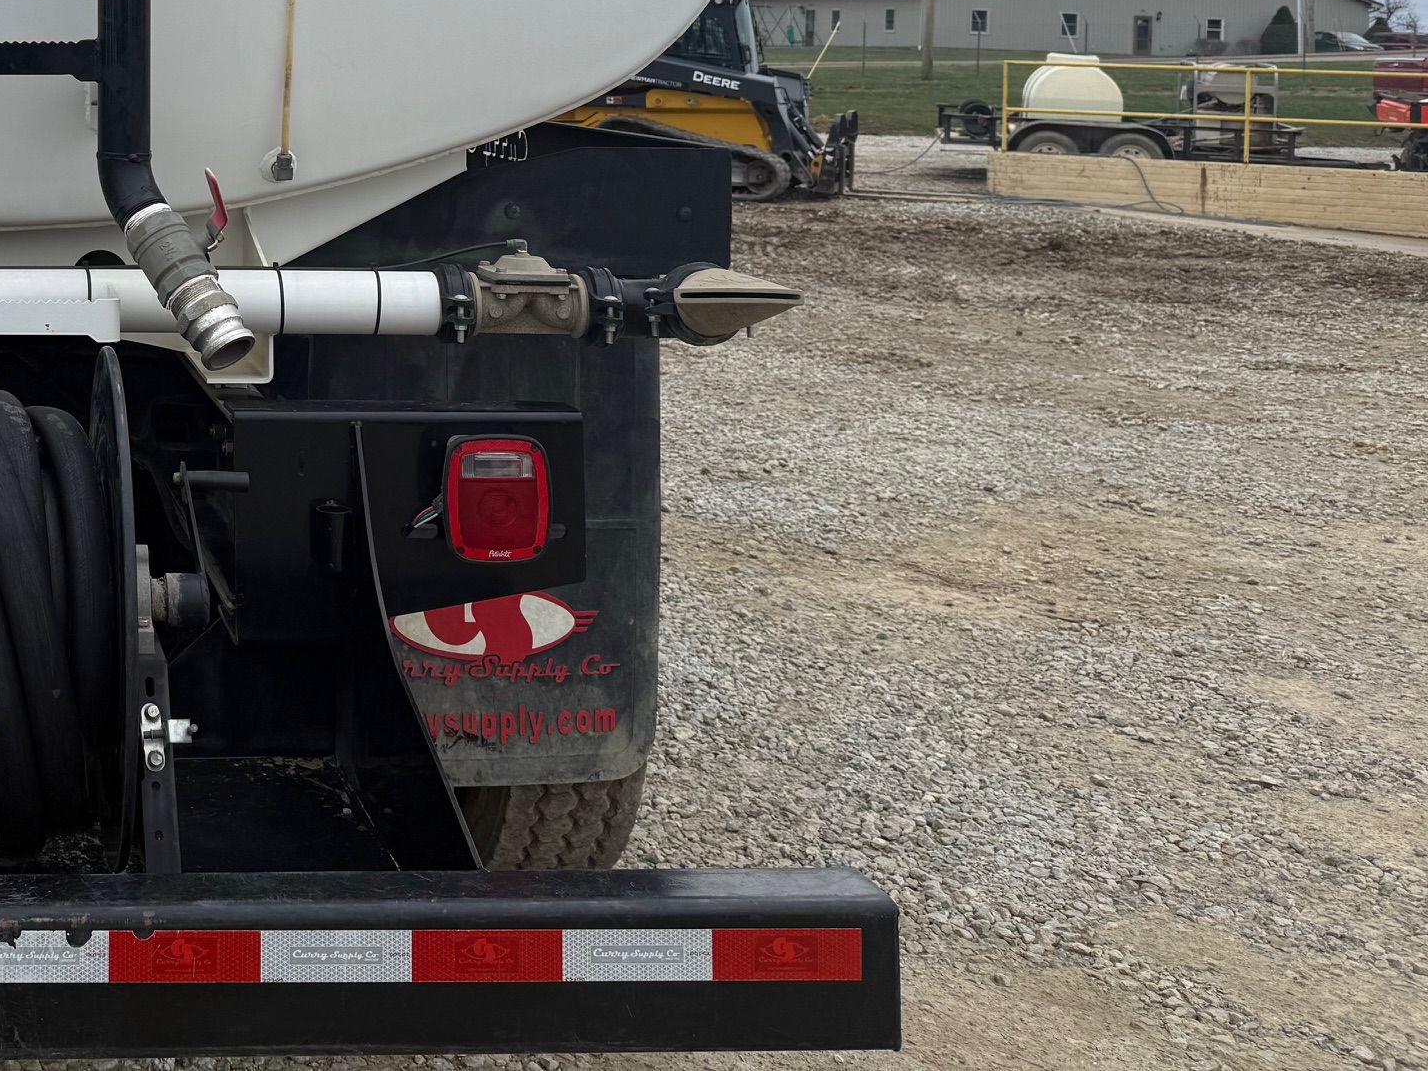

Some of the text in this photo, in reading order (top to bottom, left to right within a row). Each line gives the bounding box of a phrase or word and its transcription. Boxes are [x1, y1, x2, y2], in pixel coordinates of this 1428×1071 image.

[692, 70, 741, 91] DEERE
[402, 654, 621, 688] rry Supply Co
[423, 704, 617, 746] ysupply.com
[25, 950, 60, 961] Supply
[291, 949, 329, 961] Curry
[329, 950, 364, 961] Supply
[592, 947, 630, 960] Curry
[630, 948, 665, 960] Supply
